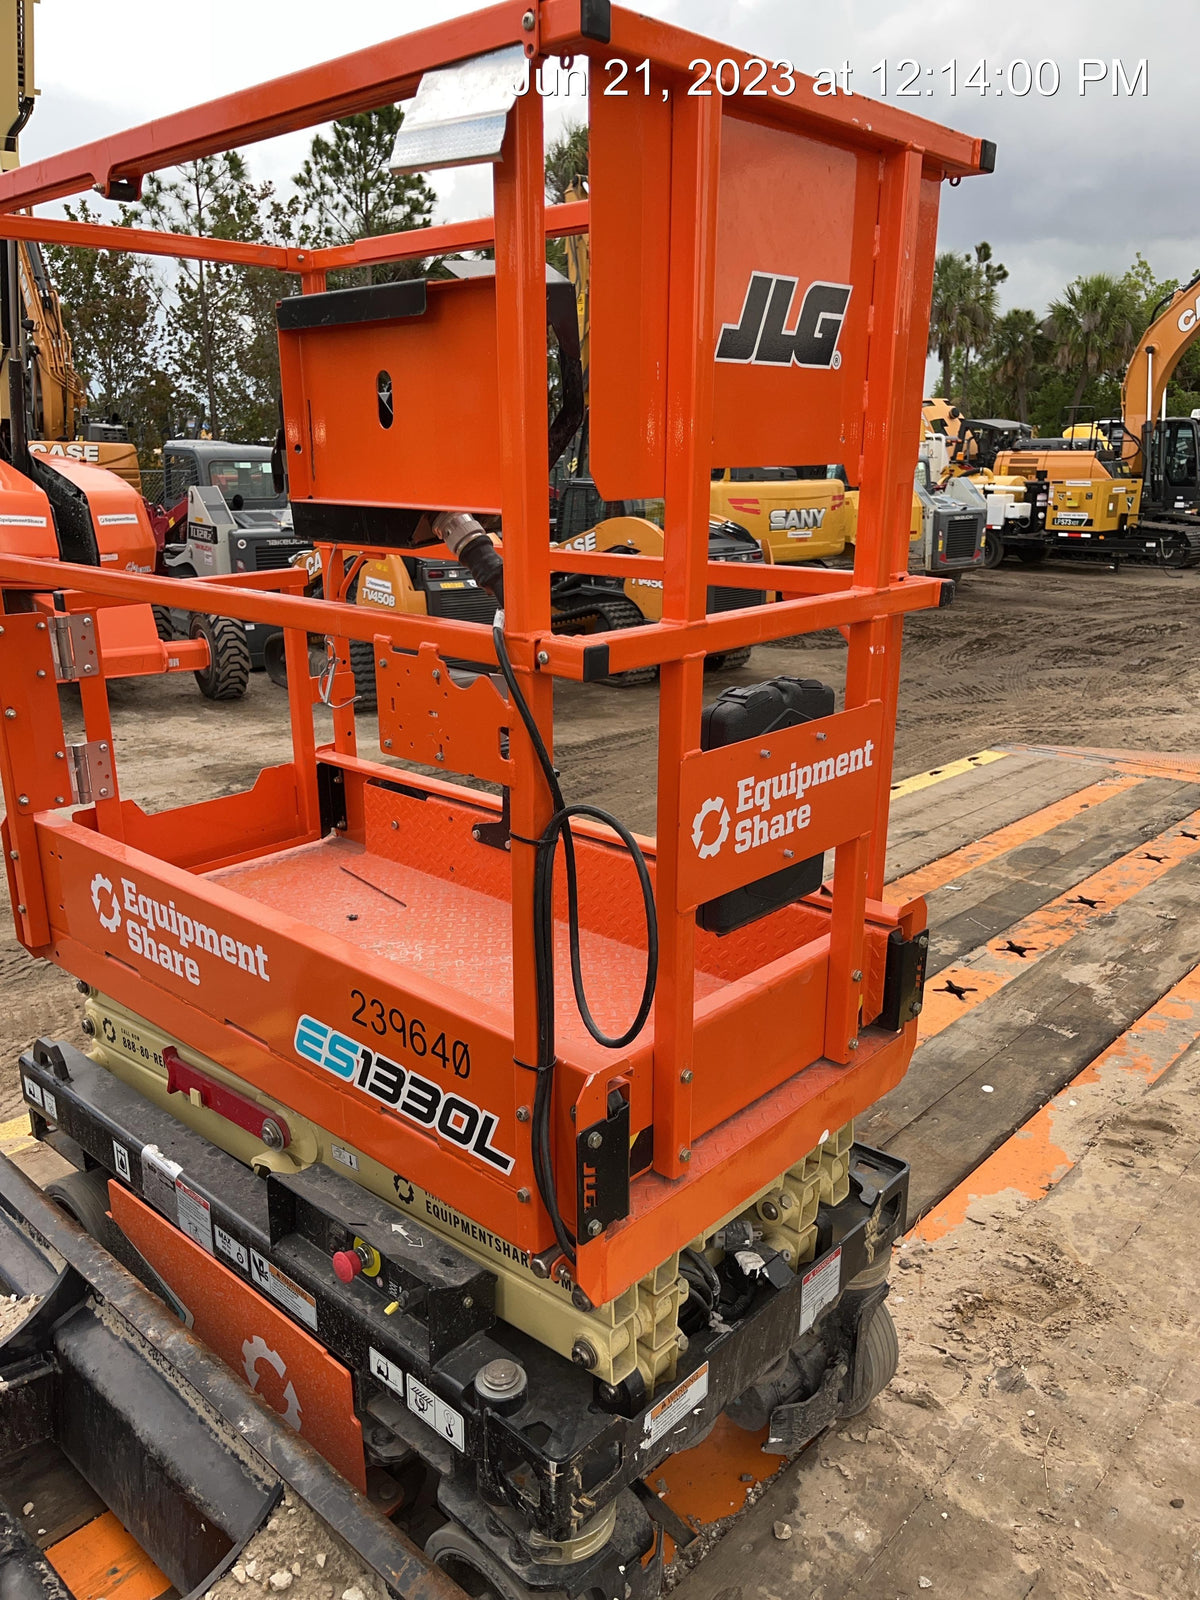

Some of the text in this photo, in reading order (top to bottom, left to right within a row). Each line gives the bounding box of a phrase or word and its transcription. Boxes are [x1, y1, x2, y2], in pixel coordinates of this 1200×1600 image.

[769, 508, 826, 531] SANY
[362, 588, 396, 607] TV450B
[736, 739, 875, 814] Equipment
[734, 804, 811, 854] Share
[120, 877, 270, 982] Equipment
[126, 919, 200, 986] Share
[351, 989, 471, 1080] 239640
[294, 1014, 516, 1176] ES1330L
